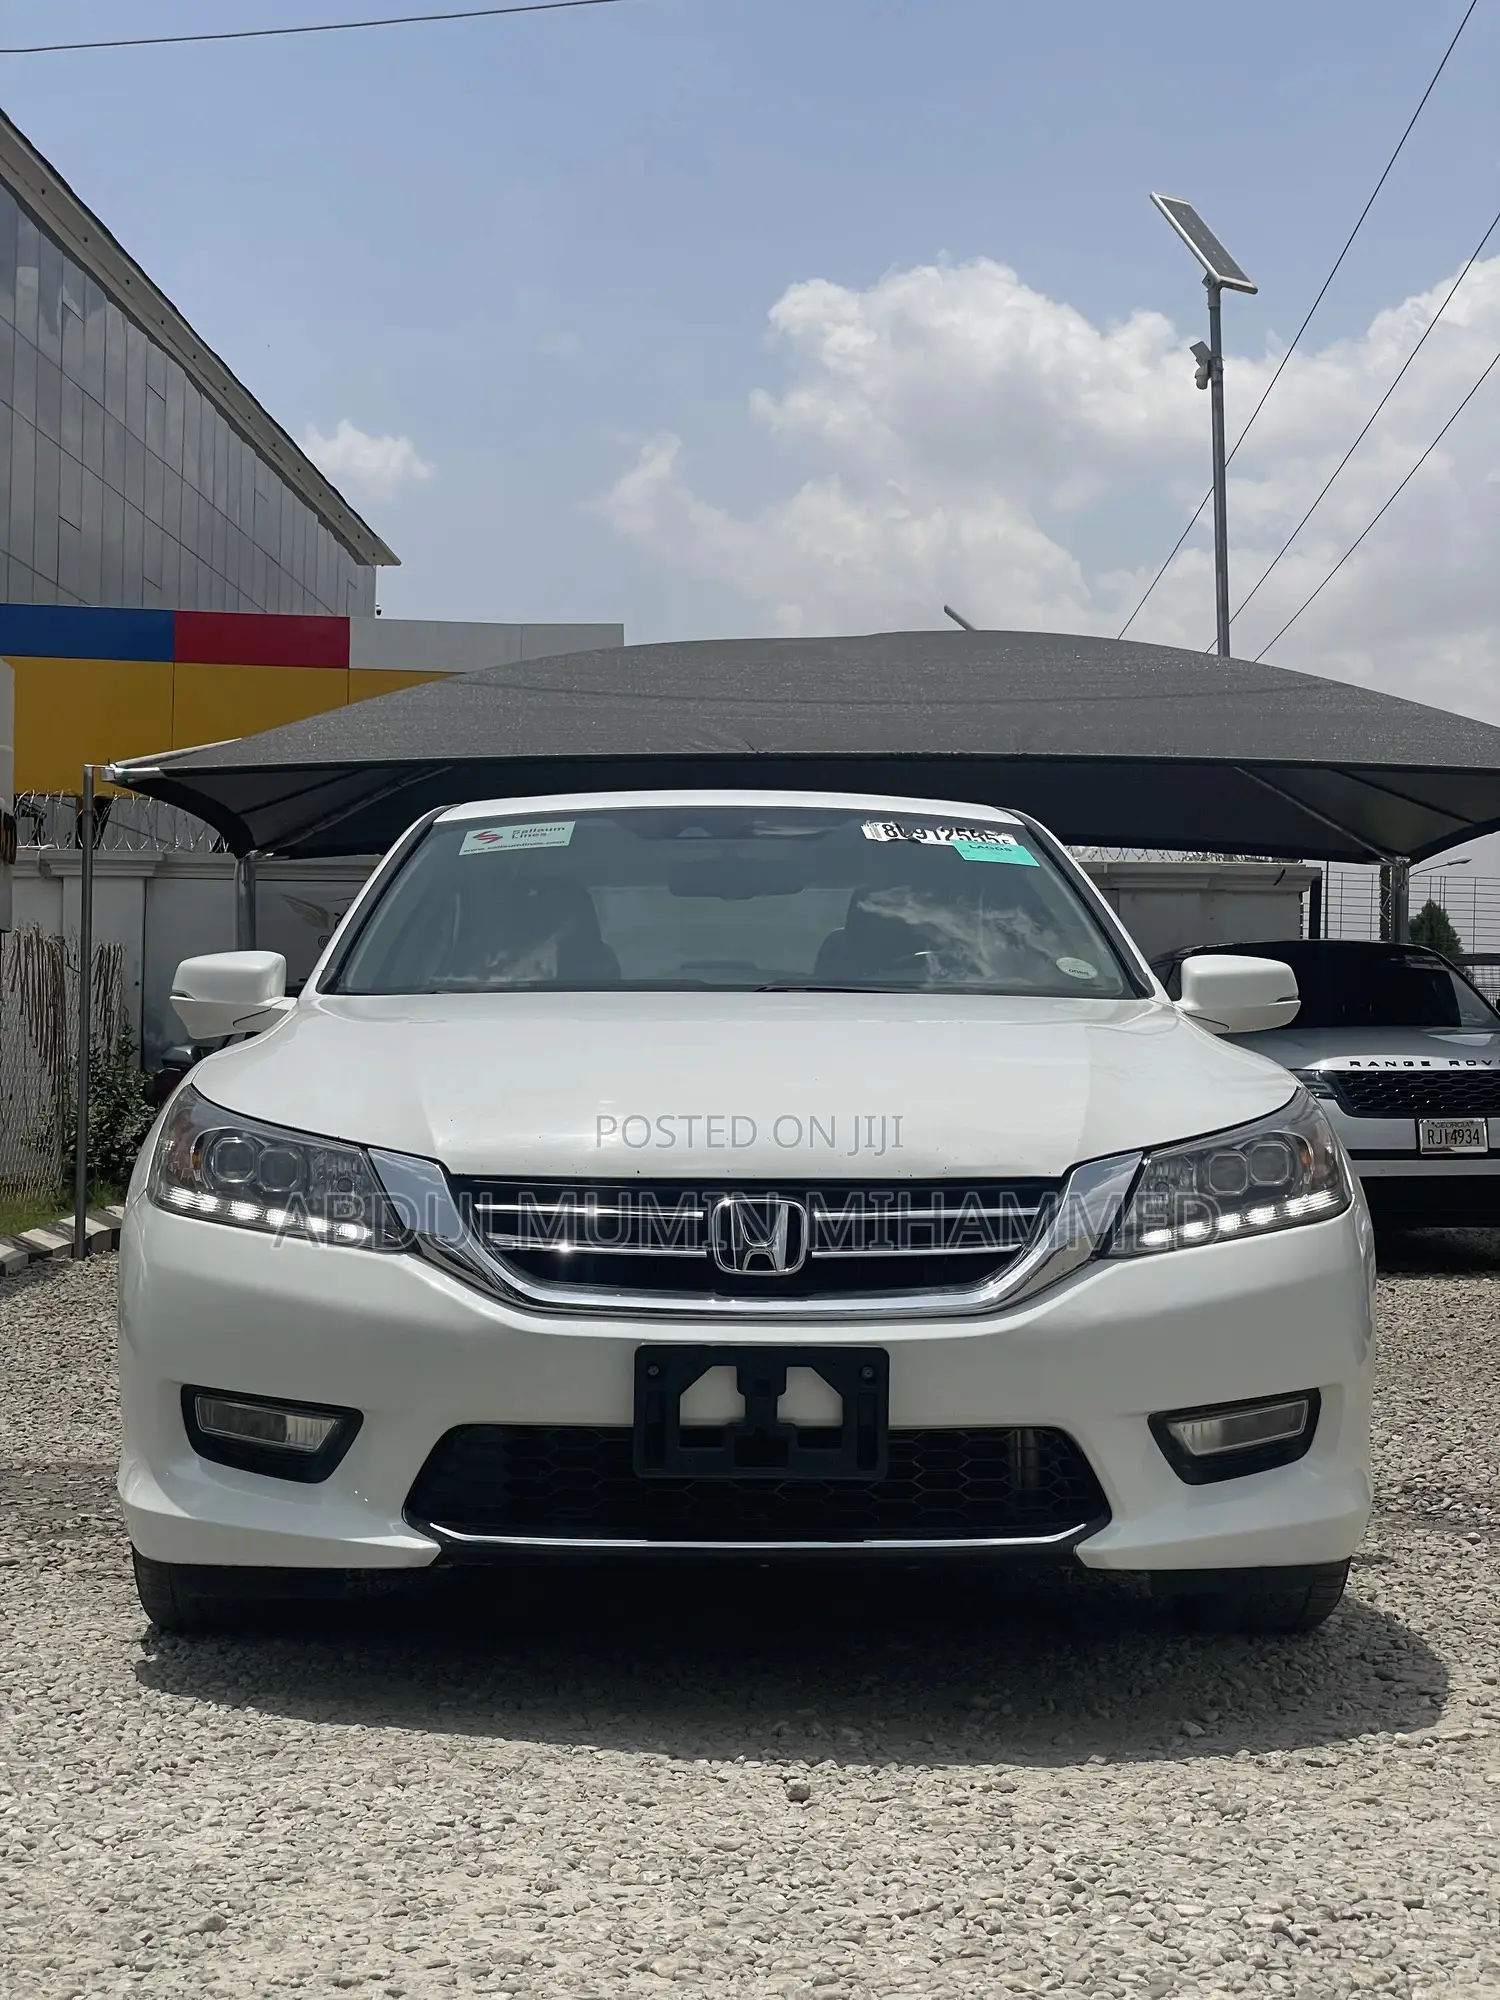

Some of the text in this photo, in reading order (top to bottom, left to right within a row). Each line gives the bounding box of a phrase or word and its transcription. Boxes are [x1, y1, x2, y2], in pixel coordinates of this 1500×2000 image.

[512, 826, 566, 835] Sallaum
[511, 832, 548, 840] Lines
[1448, 1059, 1500, 1067] ROV
[1434, 1121, 1472, 1129] GEORGIA
